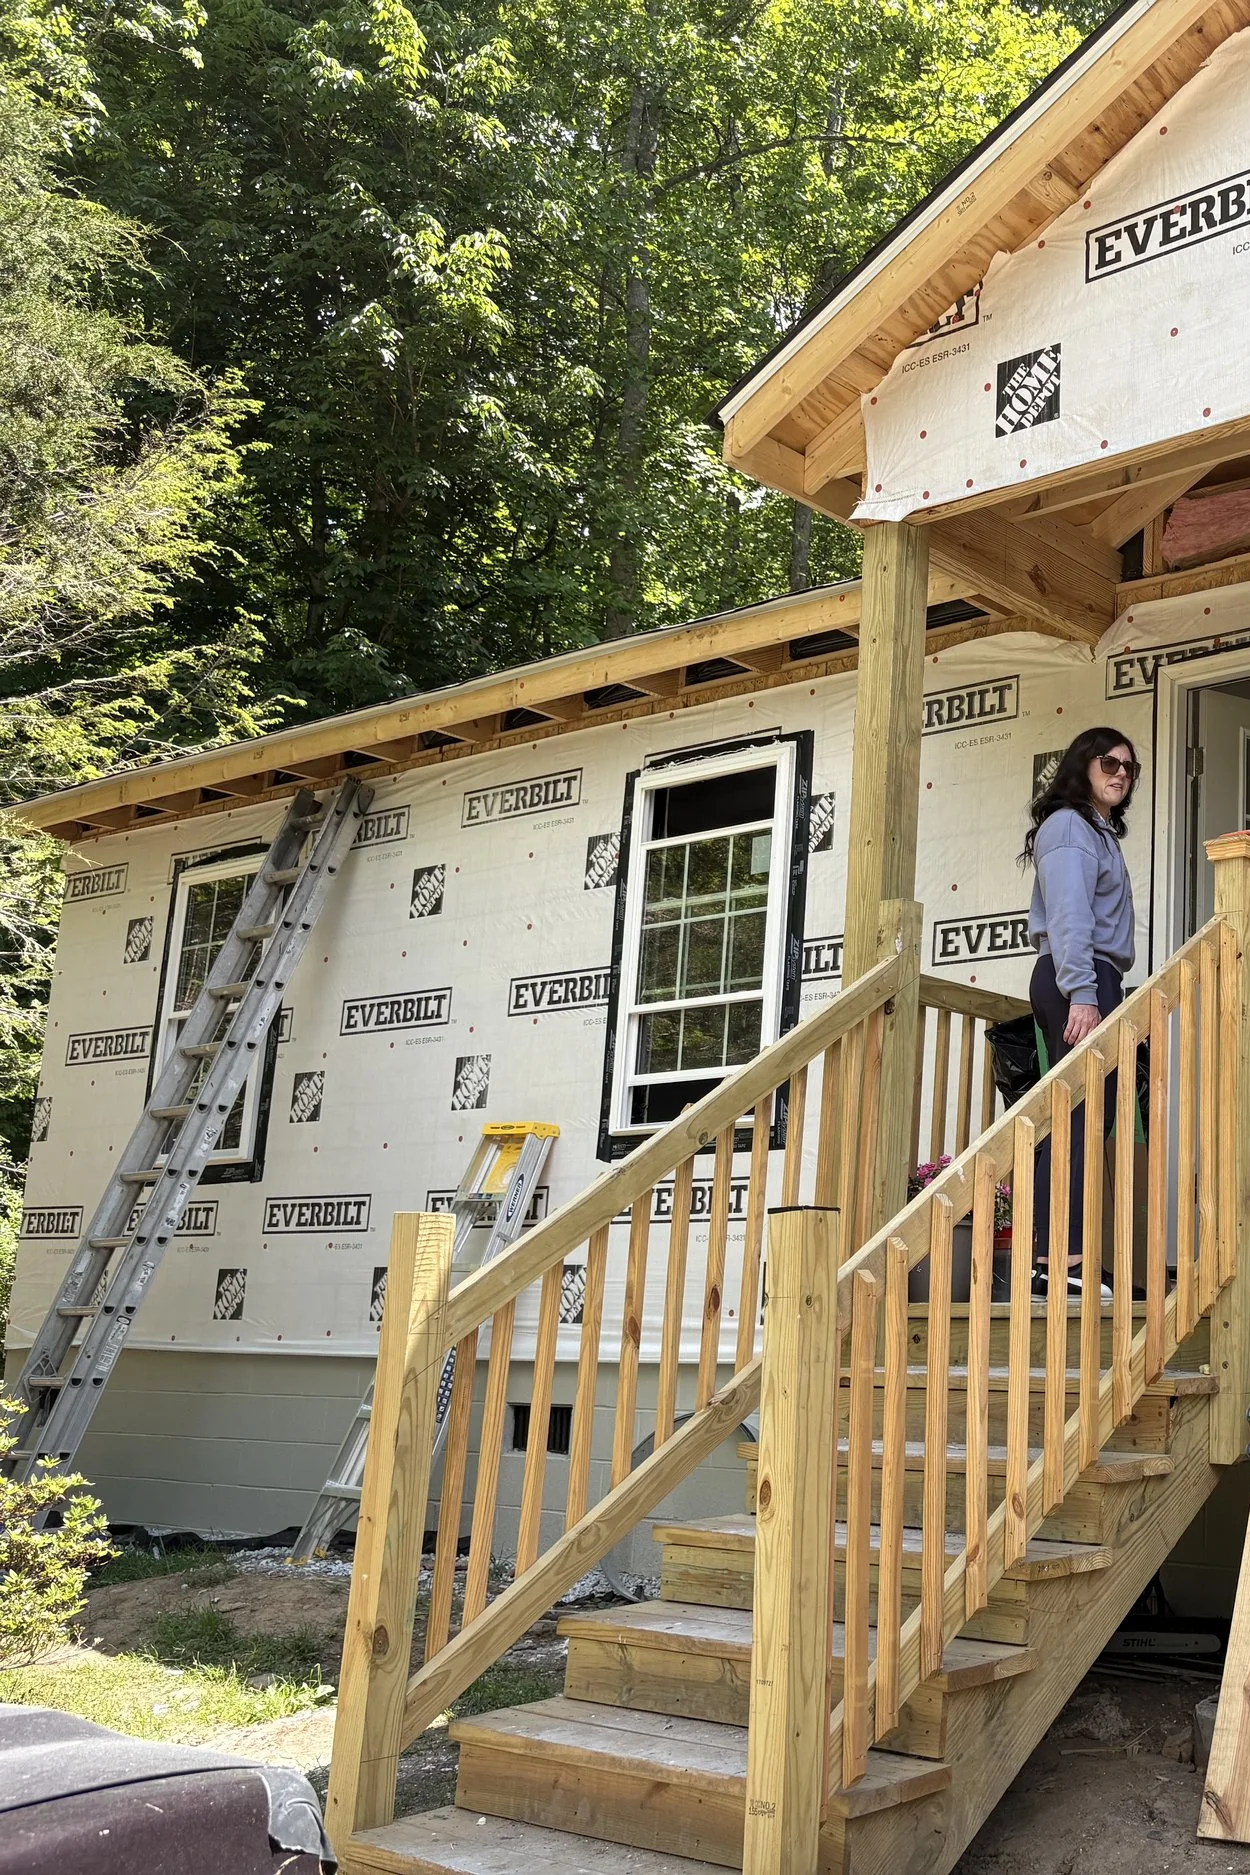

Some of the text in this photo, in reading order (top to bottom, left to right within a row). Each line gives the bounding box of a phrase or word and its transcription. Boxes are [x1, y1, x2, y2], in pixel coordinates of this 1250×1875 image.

[902, 343, 970, 373] ICC-ES ESR-3431
[996, 346, 1061, 434] HOME
[1002, 363, 1029, 397] THE
[1020, 371, 1061, 428] DEPOT
[923, 684, 1012, 728] RBILT
[954, 732, 1012, 750] ICC-ES ESR-3431
[466, 776, 577, 821] EVERBILT
[353, 812, 406, 844] BILT
[809, 793, 836, 839] OME
[589, 840, 606, 862] THE
[66, 868, 125, 898] ERBILT
[415, 872, 431, 891] THE
[599, 859, 618, 887] DEP
[409, 864, 447, 919] HOME
[939, 918, 1031, 958] EVER
[344, 994, 447, 1029] EVERBILT
[69, 1031, 149, 1060] EVERBILT
[289, 1070, 325, 1123] HOME
[508, 1182, 522, 1213] WERNER
[22, 1212, 80, 1234] ERBILT
[127, 1206, 214, 1231] EBILT
[267, 1201, 366, 1227] EVERBILT
[213, 1268, 247, 1320] HOME
[1122, 1638, 1156, 1647] STIHL
